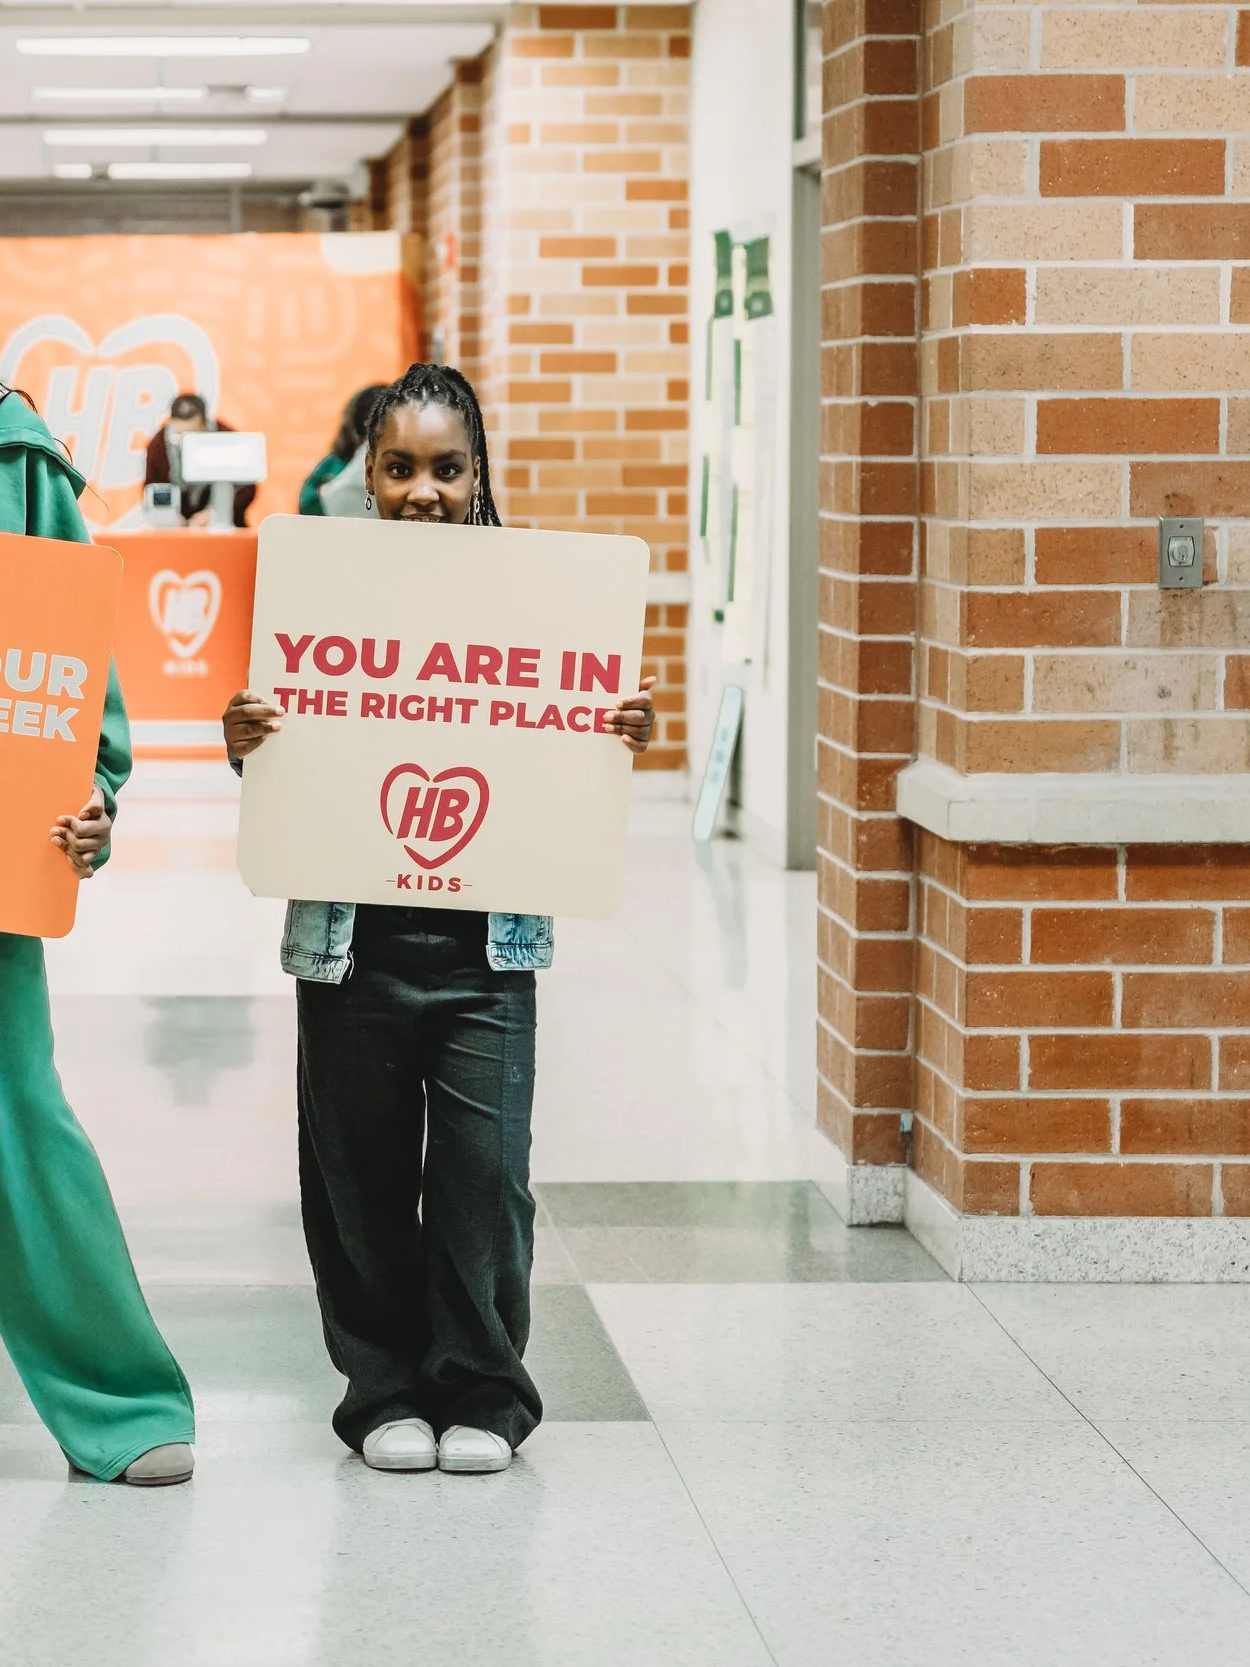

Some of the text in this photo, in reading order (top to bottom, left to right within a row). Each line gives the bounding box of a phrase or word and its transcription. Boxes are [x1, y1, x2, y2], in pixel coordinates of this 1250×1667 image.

[46, 364, 179, 489] HB
[274, 632, 622, 694] YOU ARE IN
[273, 687, 348, 717] THE
[360, 692, 478, 724] RIGHT
[396, 786, 470, 842] HB
[396, 873, 462, 893] KIDS
